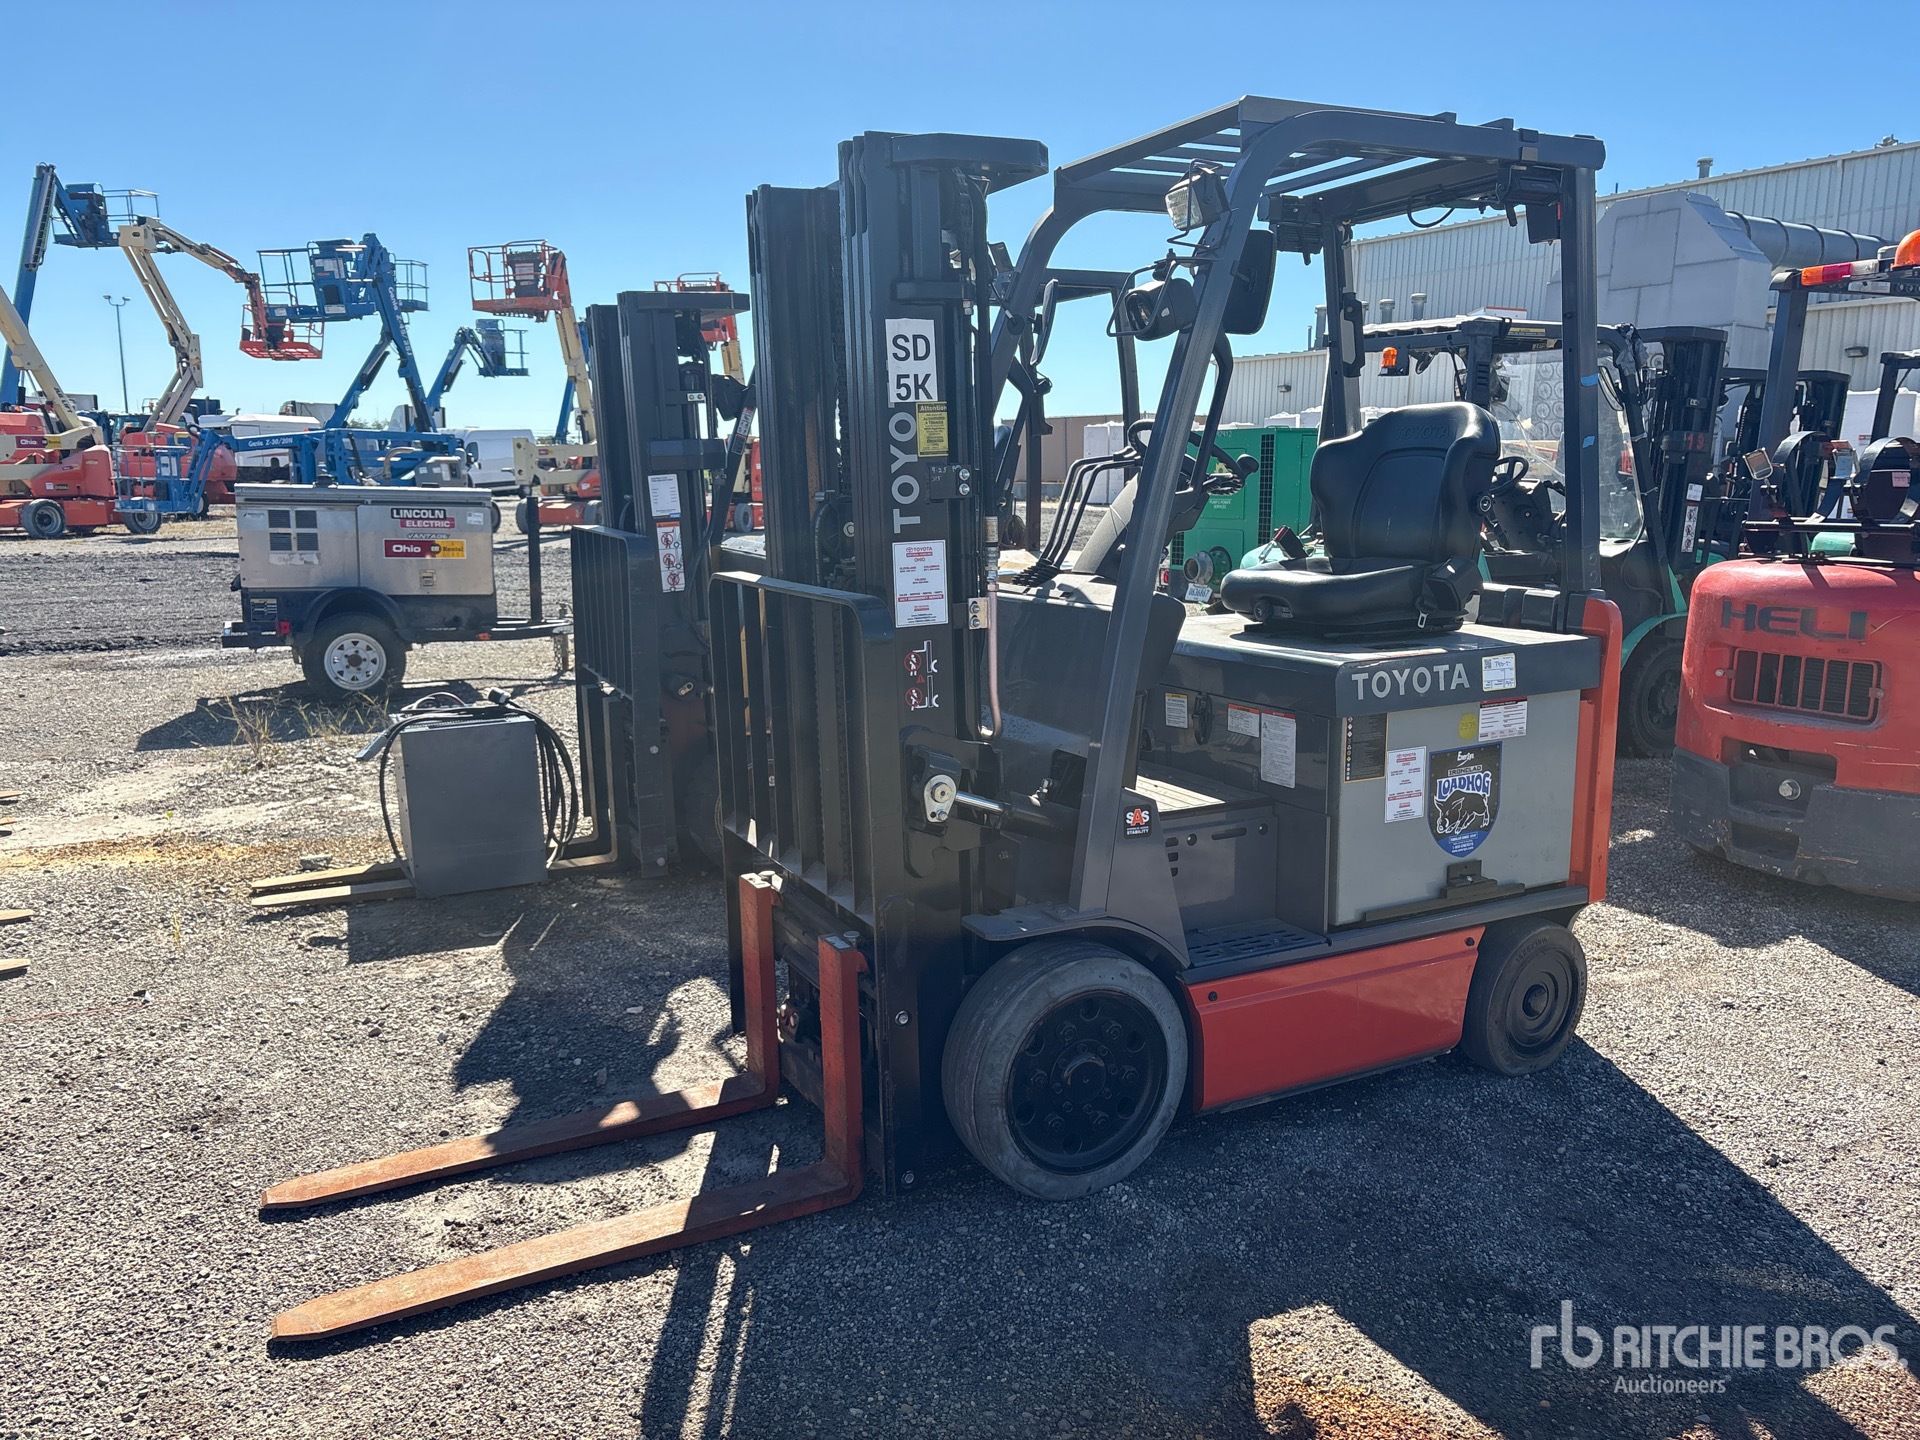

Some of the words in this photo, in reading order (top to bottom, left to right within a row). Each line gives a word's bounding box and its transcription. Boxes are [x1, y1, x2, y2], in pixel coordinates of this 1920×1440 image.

[891, 333, 931, 362] SD
[895, 373, 934, 401] 5K
[1396, 423, 1450, 440] TOYOTA
[20, 438, 37, 446] Ohio
[887, 378, 921, 534] TOYO
[393, 509, 444, 519] LINCOLN
[405, 520, 451, 528] ELECTRIC
[392, 544, 421, 553] Ohio
[1720, 599, 1869, 641] HELI
[1351, 662, 1471, 701] TOYOTA
[1448, 765, 1482, 776] IRONCLAD
[1437, 771, 1492, 802] LOADHOG
[1125, 808, 1150, 826] SAS
[1126, 828, 1150, 836] STABILITY
